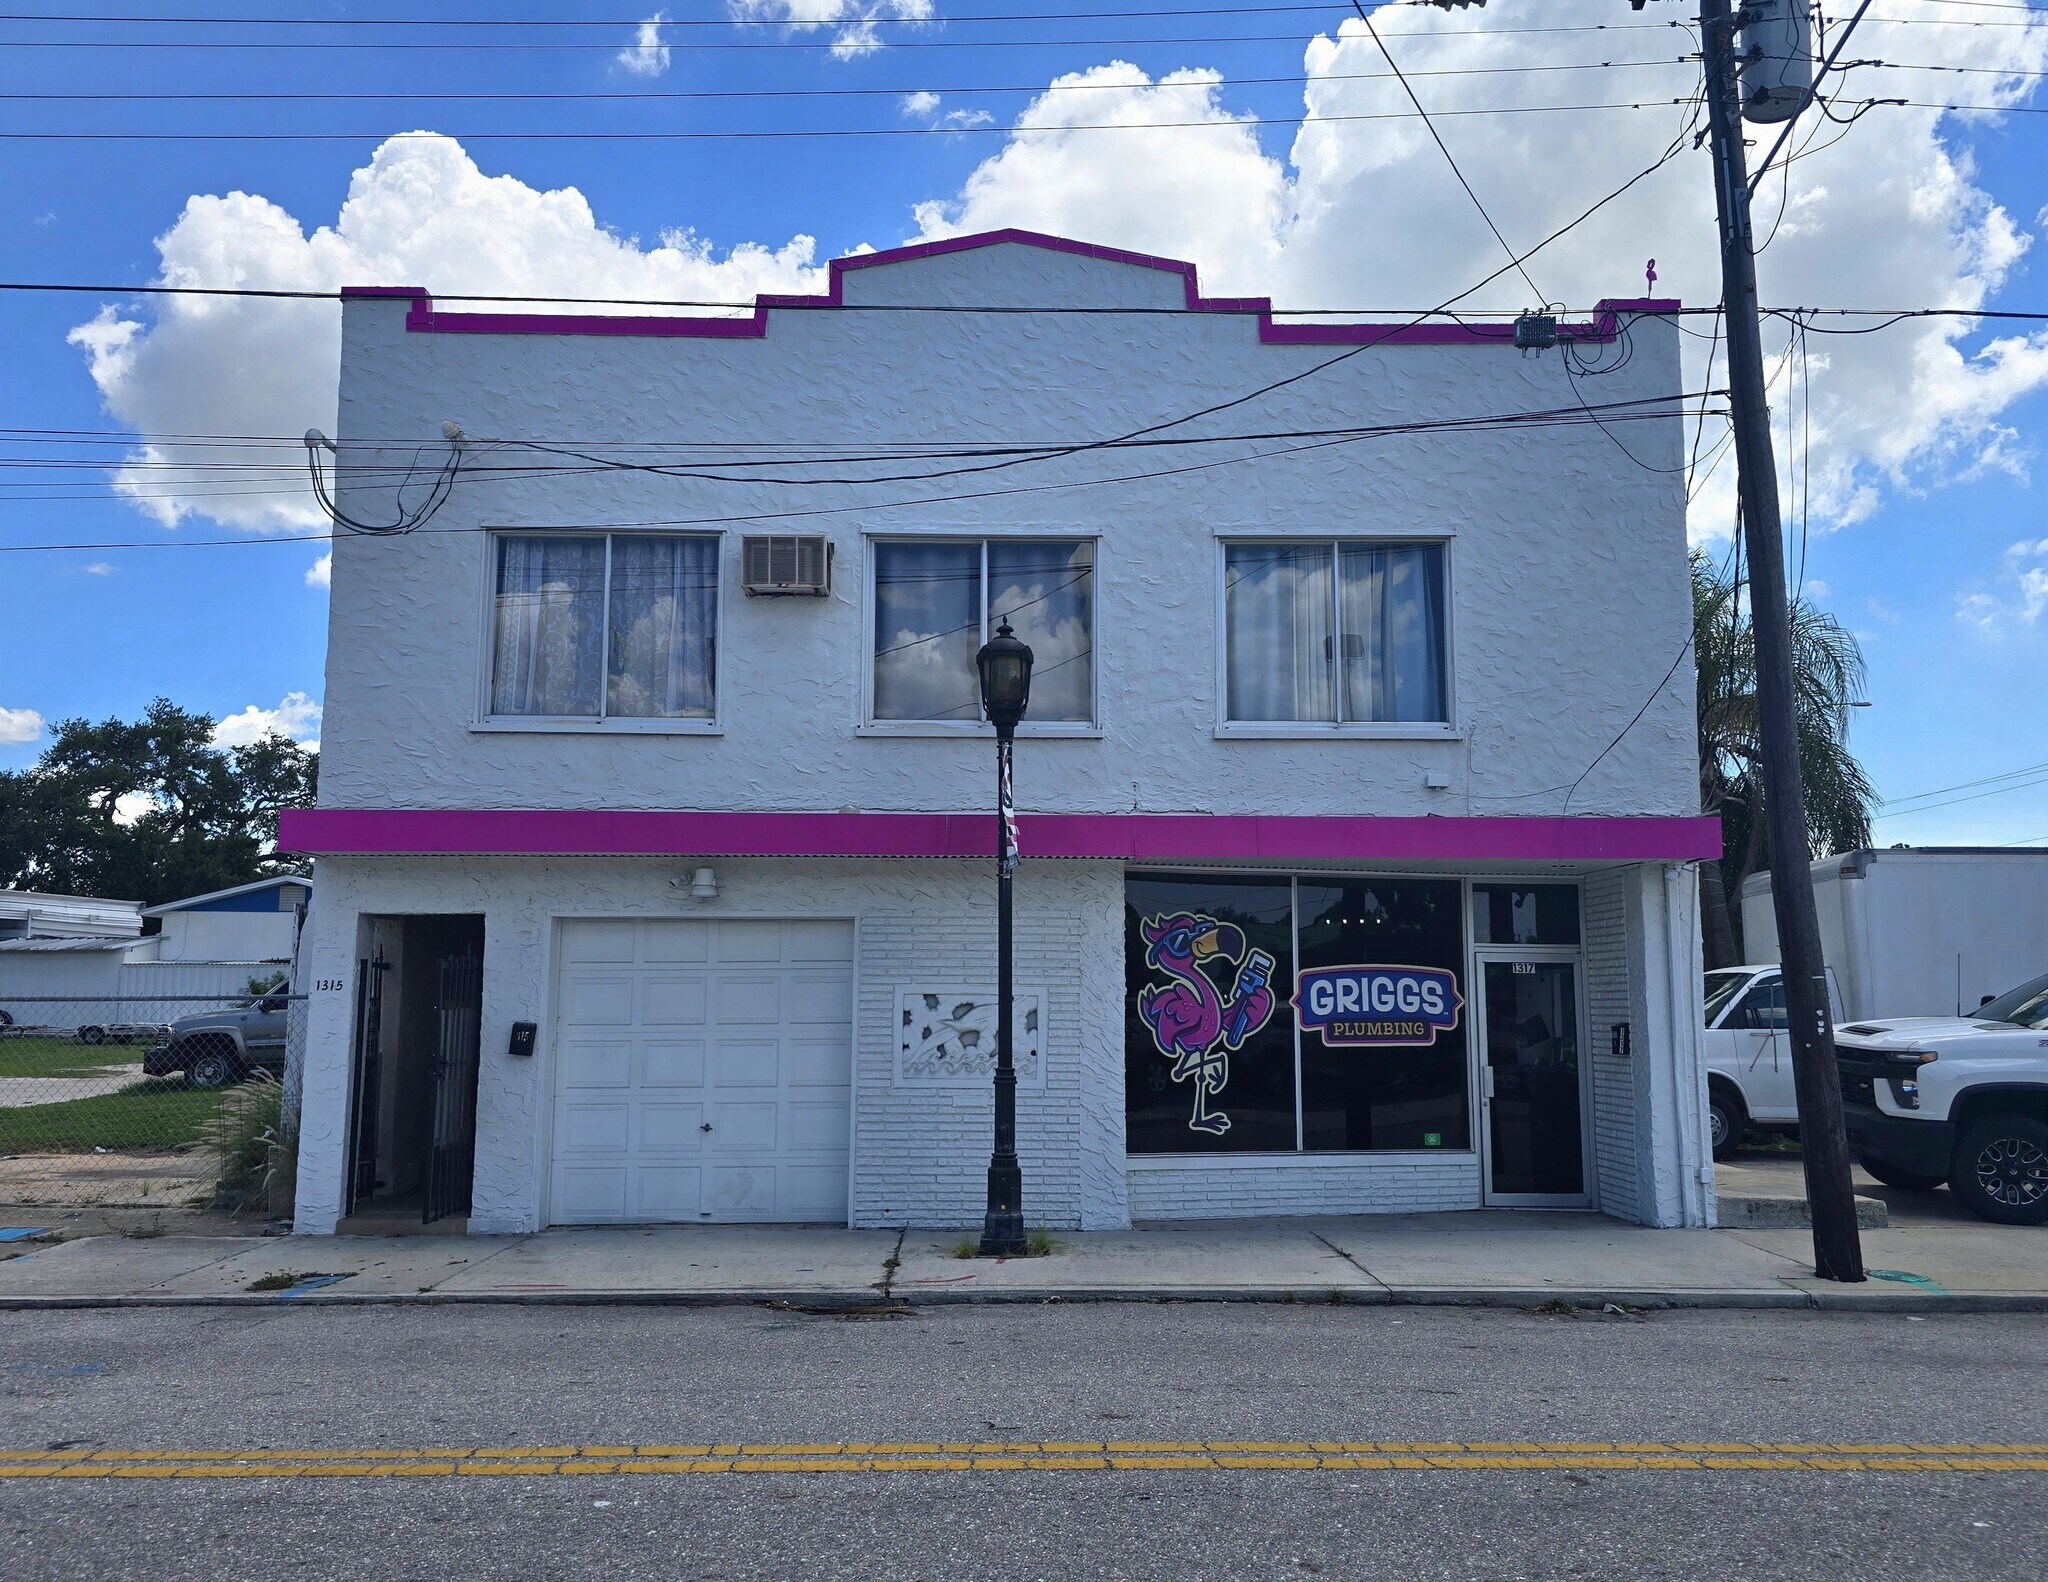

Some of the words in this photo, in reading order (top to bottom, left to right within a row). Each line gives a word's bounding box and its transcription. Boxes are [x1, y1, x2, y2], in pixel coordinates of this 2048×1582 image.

[1513, 962, 1535, 973] 1317
[316, 979, 343, 991] 1315
[1310, 976, 1444, 1016] GRIGGS
[1333, 1022, 1425, 1036] PLUMBING
